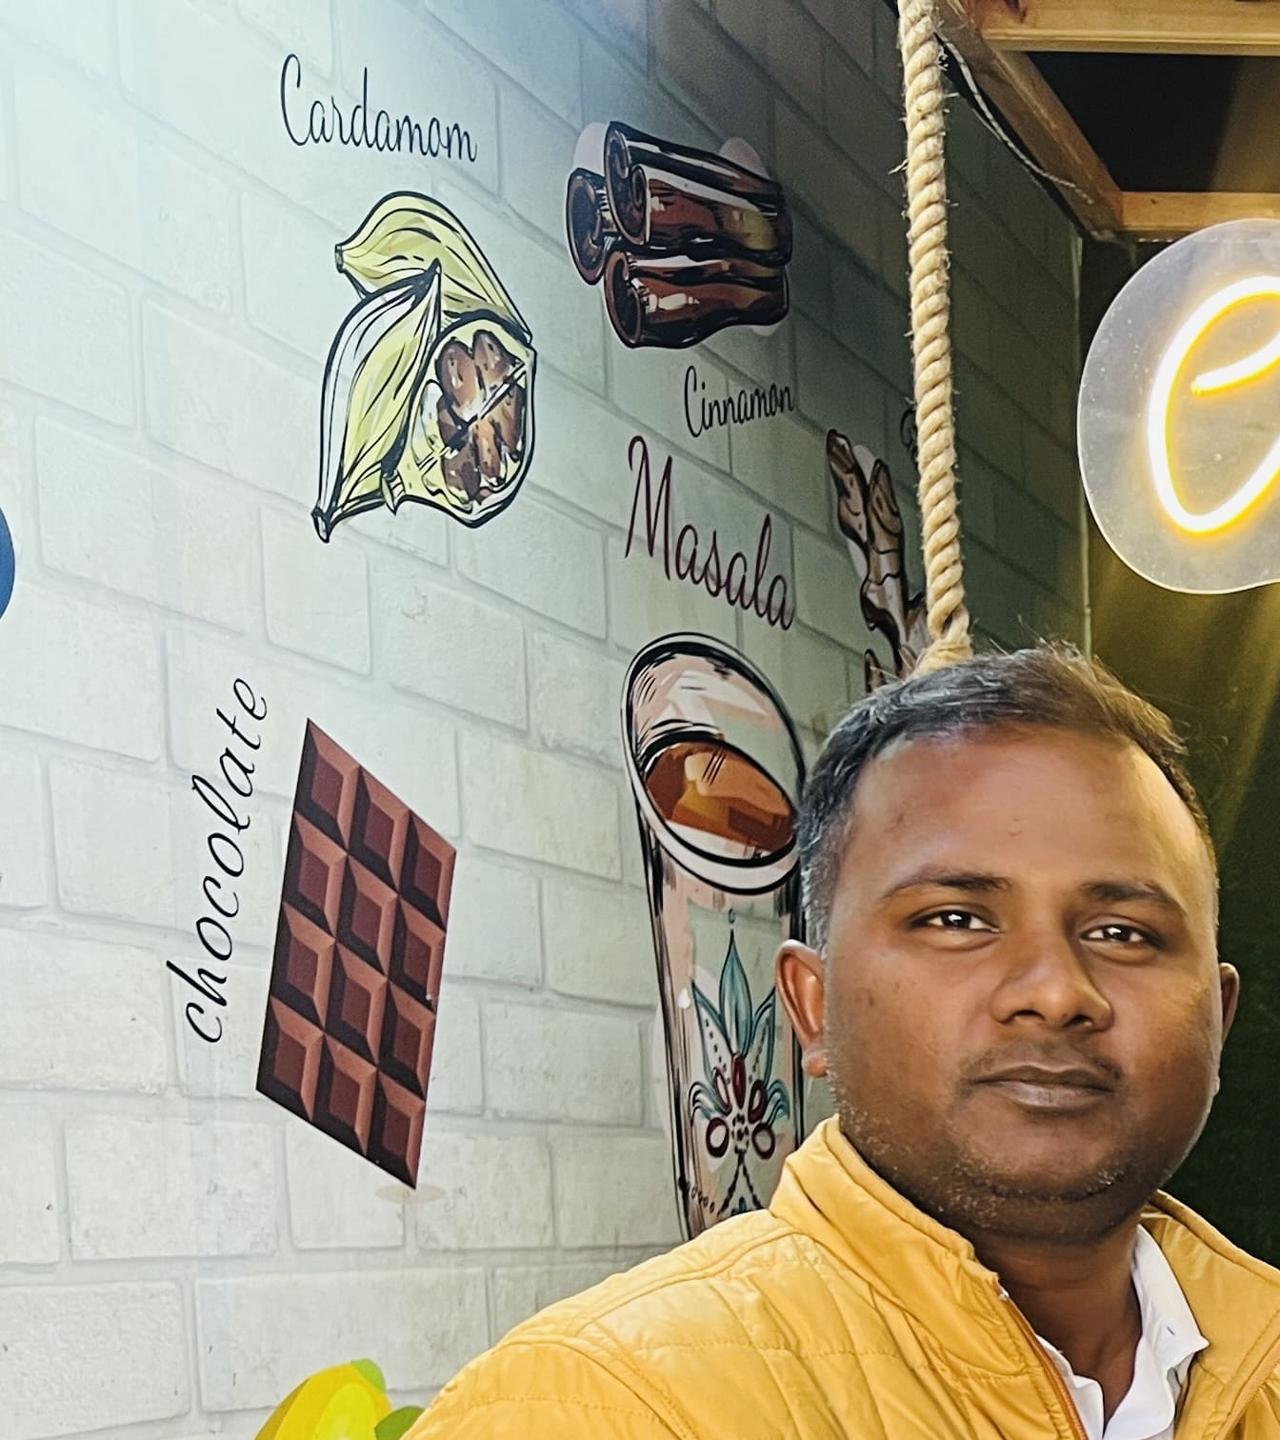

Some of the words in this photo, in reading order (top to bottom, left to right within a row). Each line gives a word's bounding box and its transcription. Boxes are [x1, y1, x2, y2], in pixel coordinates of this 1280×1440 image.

[280, 53, 478, 162] Cardamom
[684, 365, 795, 437] Cinnamon
[625, 435, 796, 631] Masala
[166, 678, 267, 1043] chocolate
